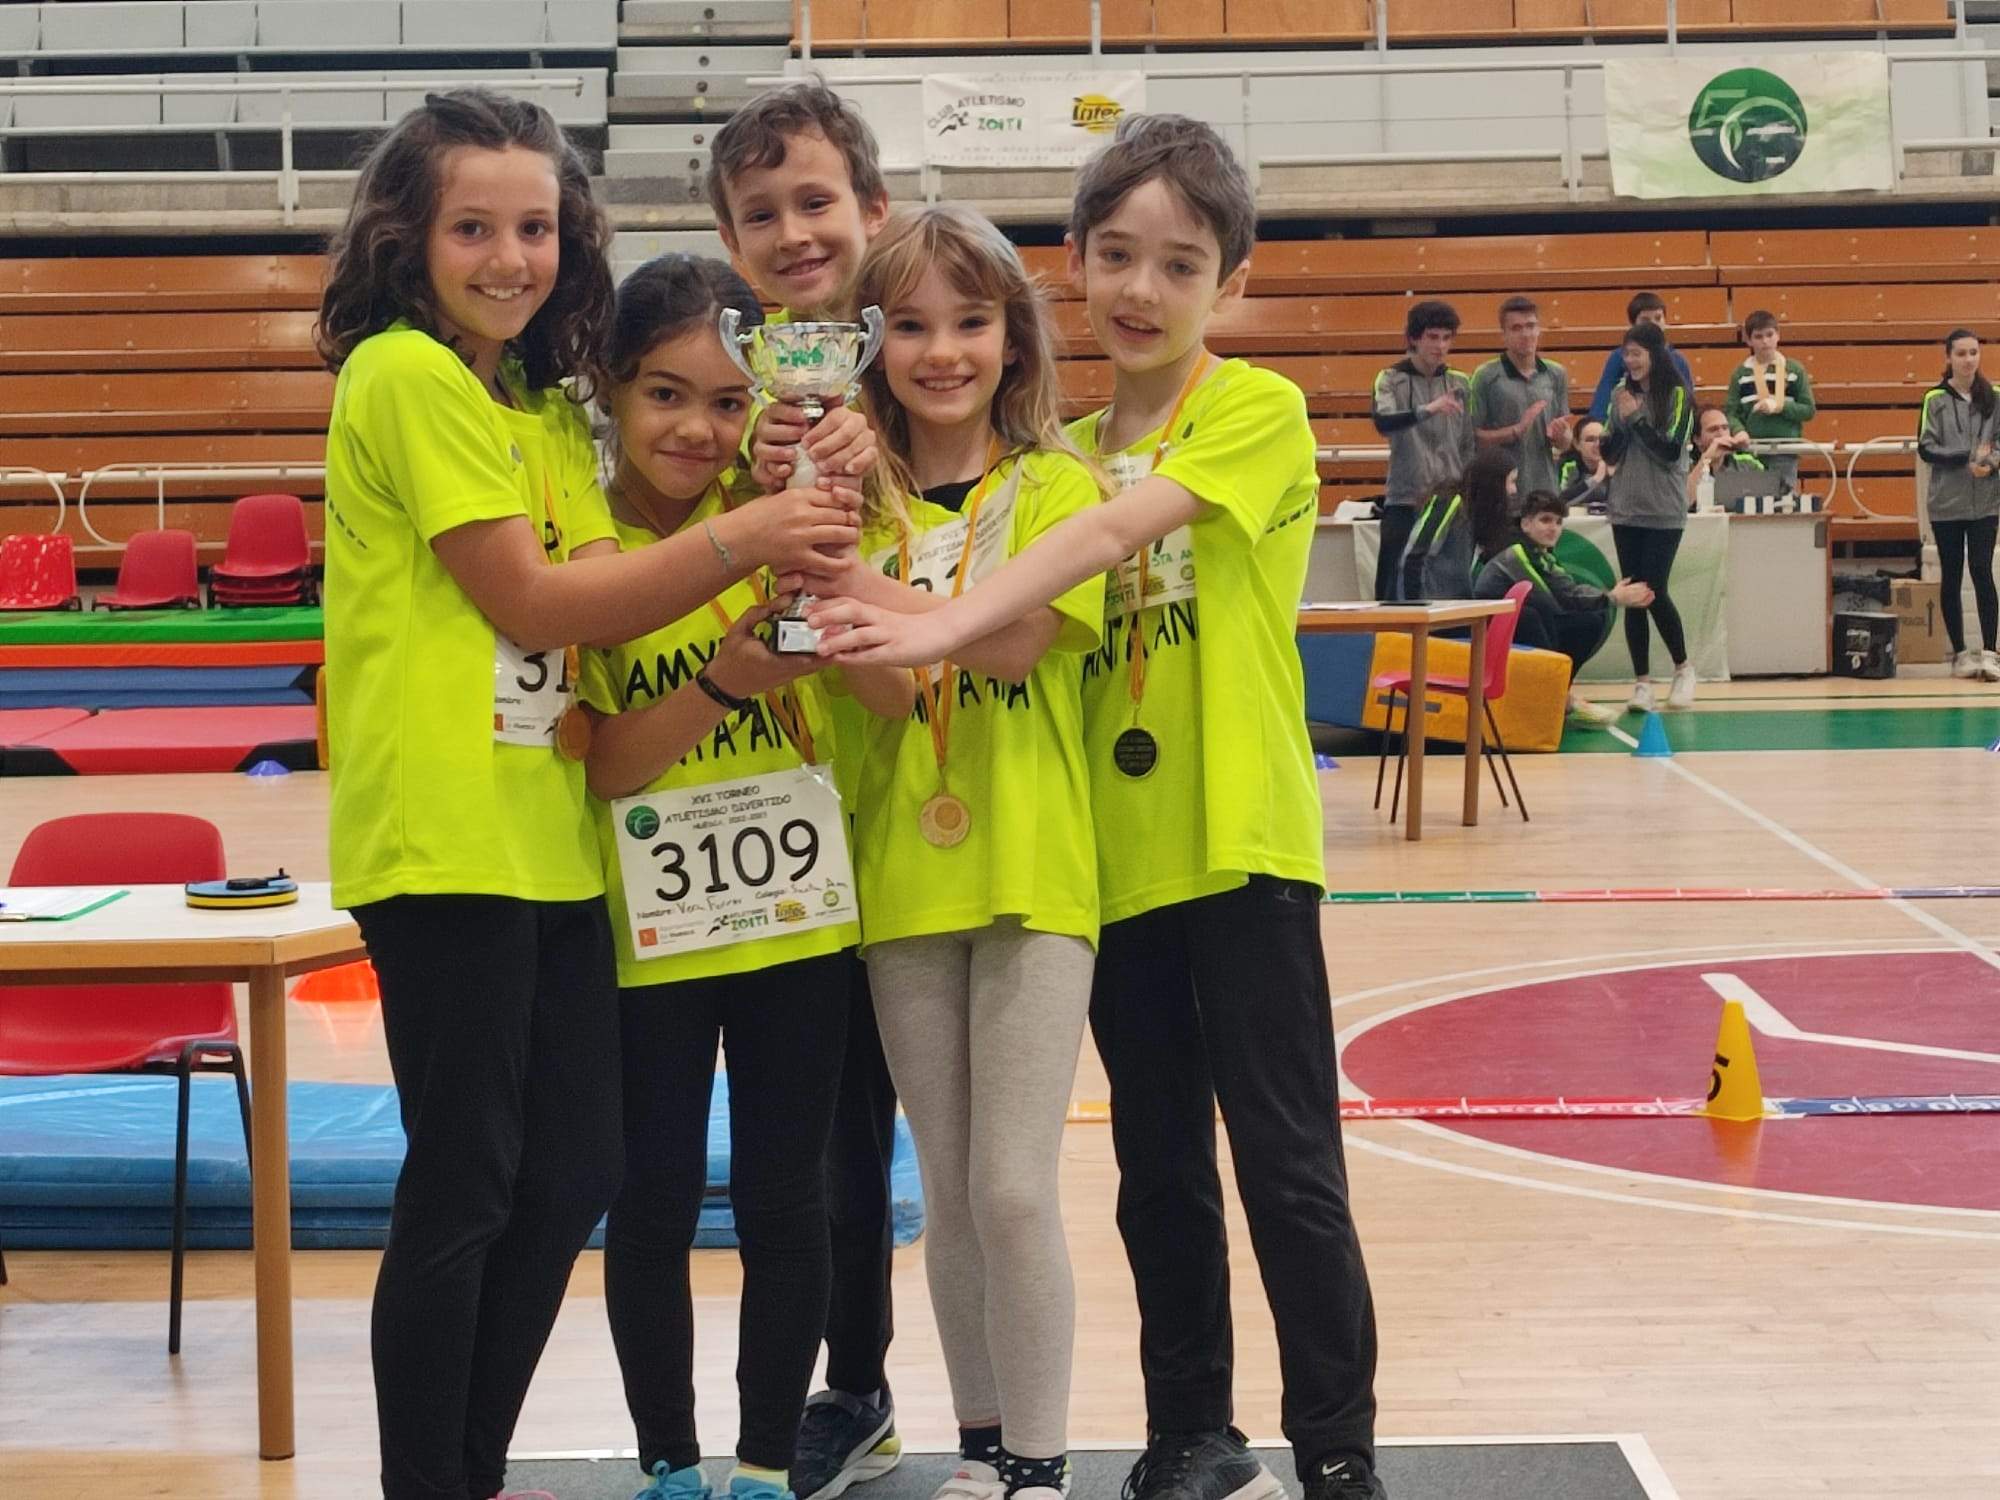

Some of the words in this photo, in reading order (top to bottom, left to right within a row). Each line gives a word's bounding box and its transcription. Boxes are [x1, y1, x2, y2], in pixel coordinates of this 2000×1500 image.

[927, 103, 953, 129] CLUB
[957, 94, 1026, 109] ATLETISMO
[715, 785, 760, 801] TORNEO
[664, 805, 729, 825] ATLETISMO
[731, 794, 792, 813] DIVERTIDO
[651, 818, 819, 902] 3109
[730, 913, 769, 932] ZOITI
